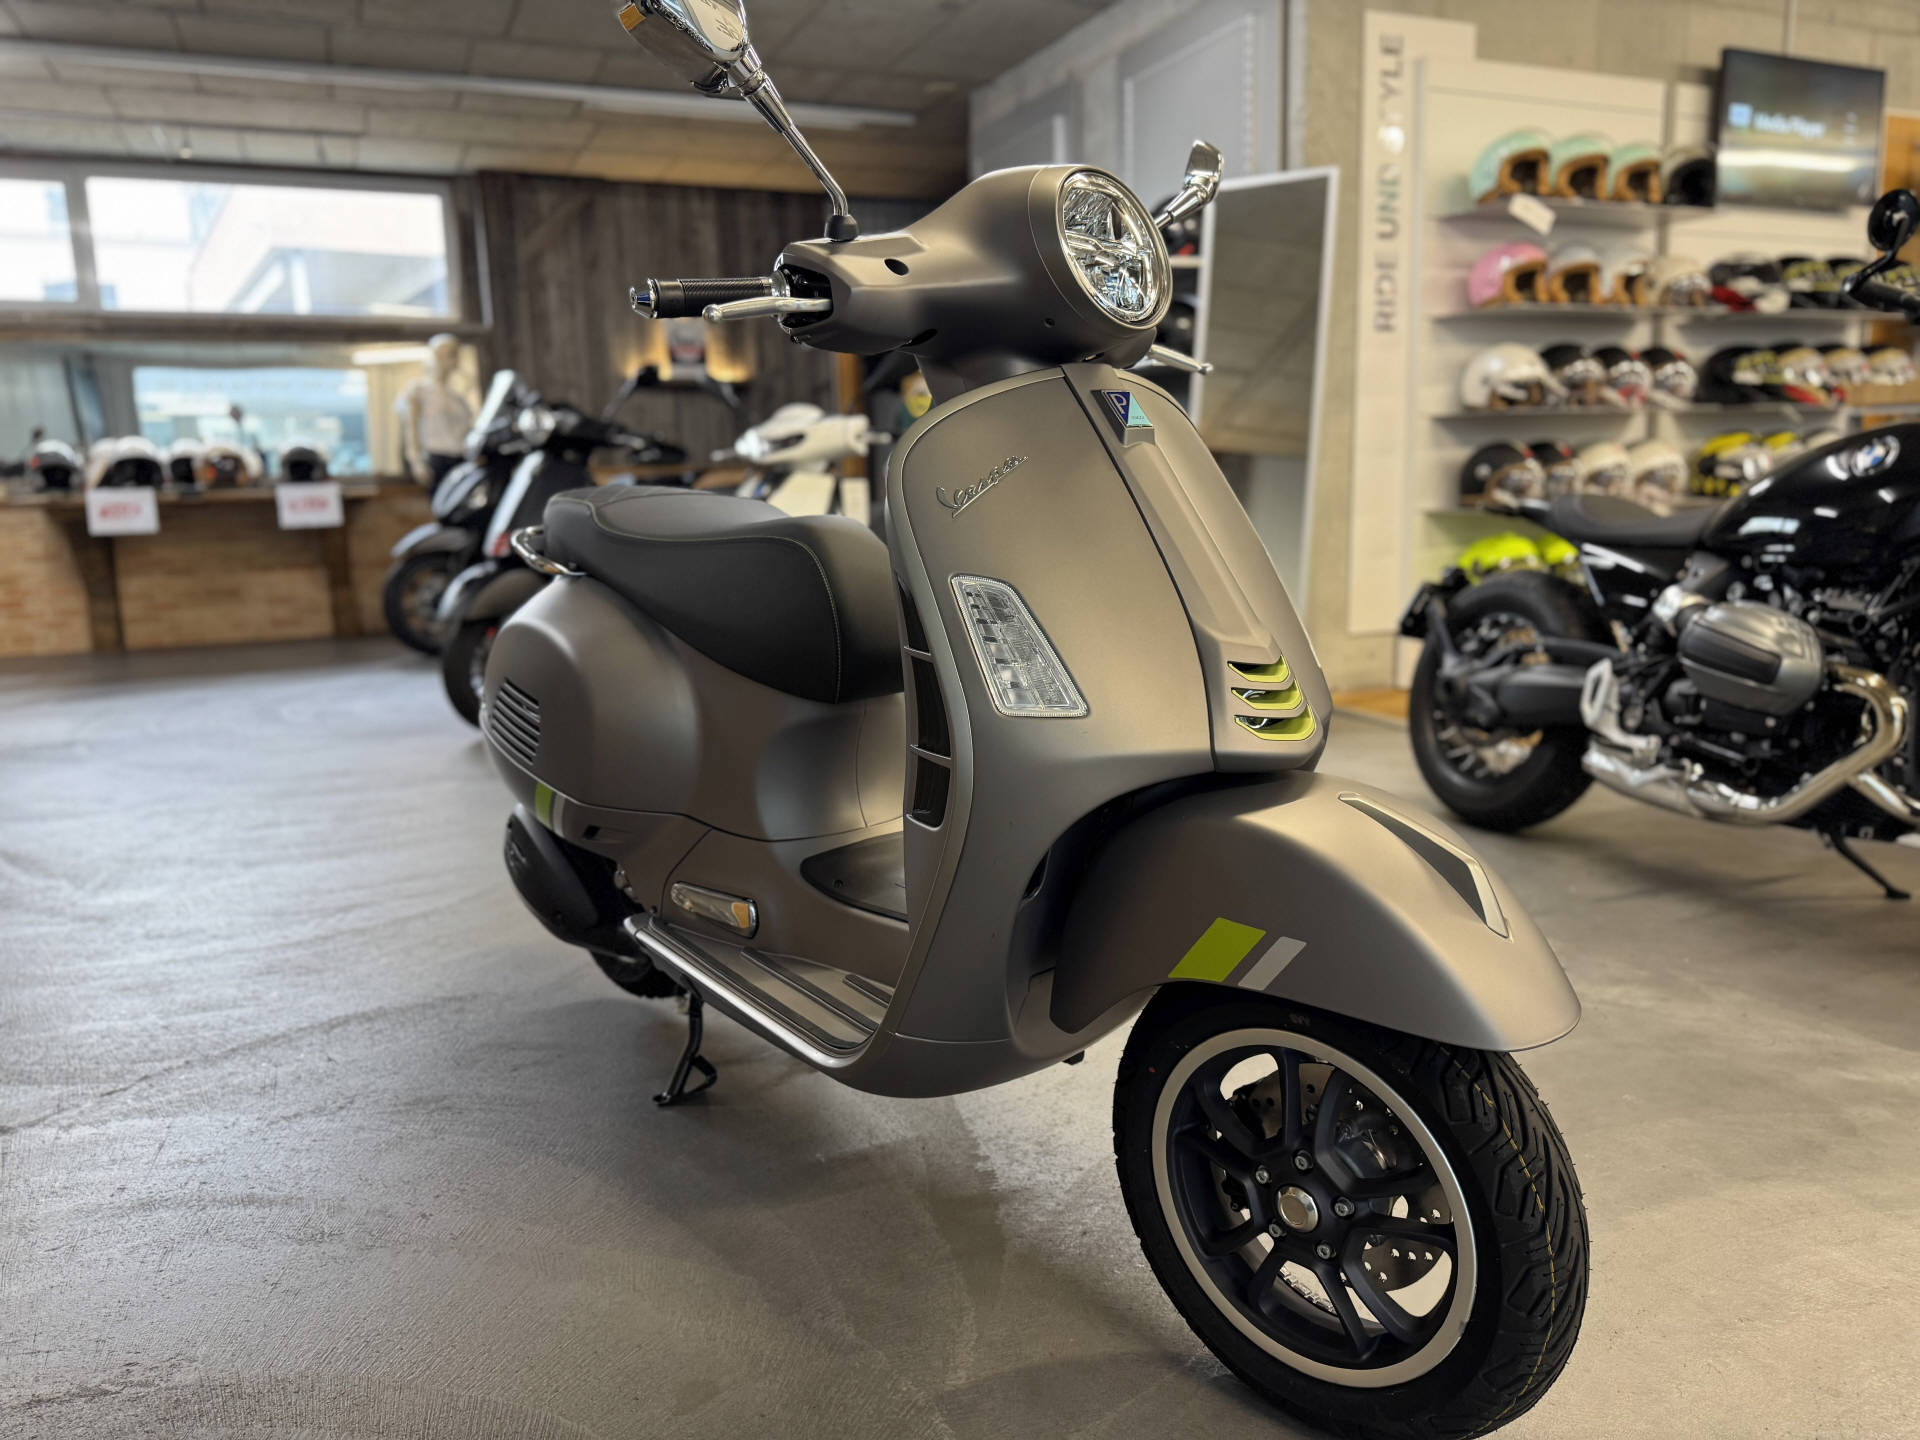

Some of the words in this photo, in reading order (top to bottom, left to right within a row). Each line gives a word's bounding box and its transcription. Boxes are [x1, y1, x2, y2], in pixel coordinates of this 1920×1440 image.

[1377, 33, 1405, 153] YLE
[1374, 164, 1401, 241] UND
[1372, 251, 1399, 334] RIDE
[1109, 393, 1127, 415] P
[935, 454, 1029, 518] Vespa
